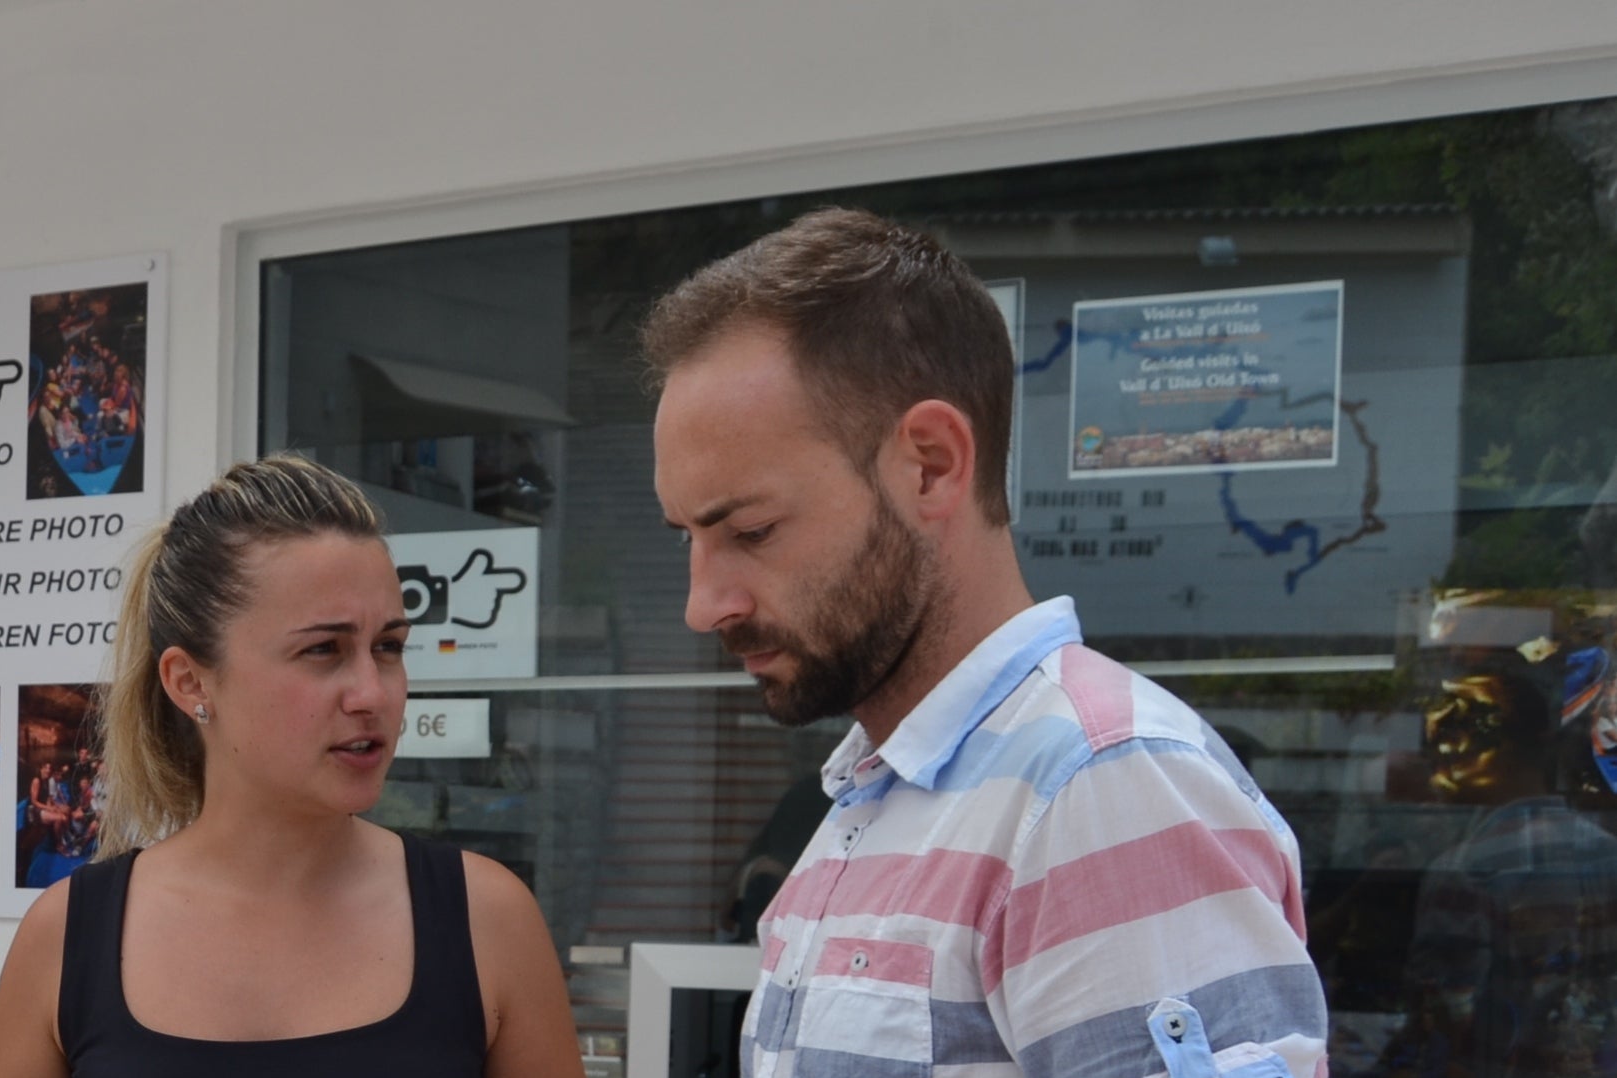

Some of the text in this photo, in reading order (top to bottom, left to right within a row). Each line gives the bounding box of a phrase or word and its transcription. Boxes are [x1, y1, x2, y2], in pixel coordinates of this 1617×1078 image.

[1205, 372, 1235, 388] Old
[29, 513, 124, 542] PHOTO
[29, 567, 122, 594] PHOTO
[416, 713, 447, 738] 6€
